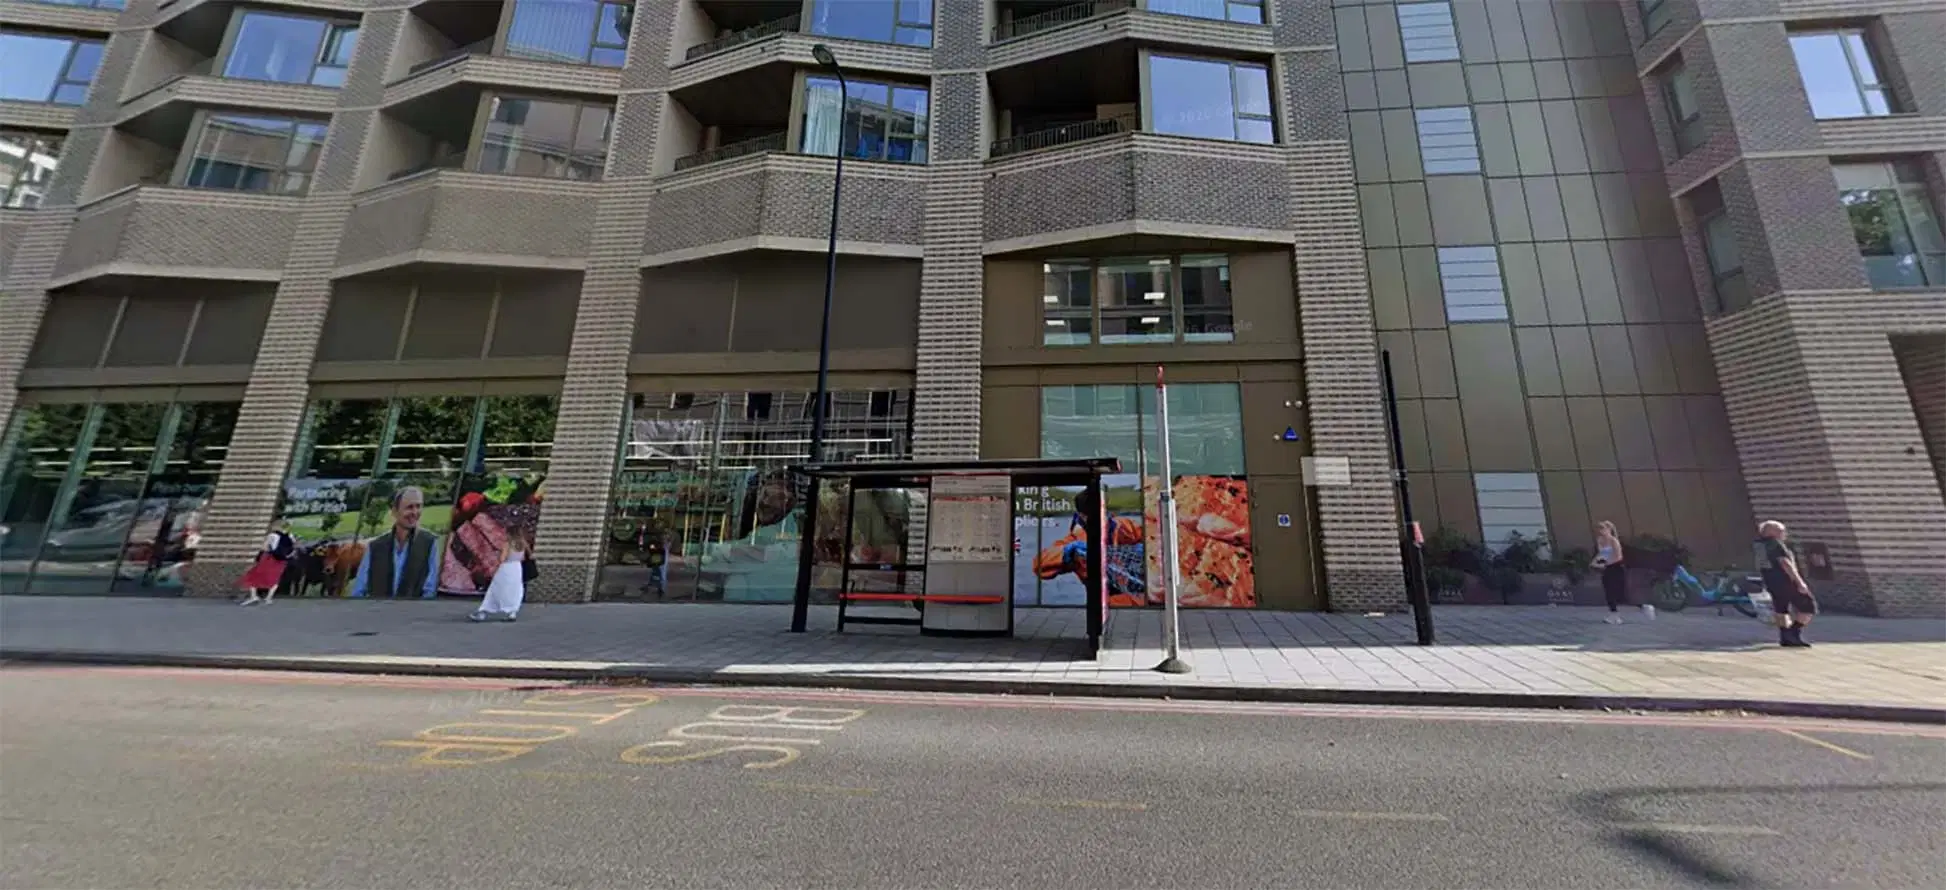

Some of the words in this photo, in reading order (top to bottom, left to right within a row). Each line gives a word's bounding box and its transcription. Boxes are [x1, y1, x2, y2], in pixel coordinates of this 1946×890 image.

[287, 487, 347, 501] Partnering
[284, 501, 309, 513] with
[310, 500, 347, 513] British
[1023, 498, 1071, 511] British
[1015, 514, 1060, 530] pliers.
[376, 691, 661, 767] STOP
[620, 704, 870, 768] BUS
